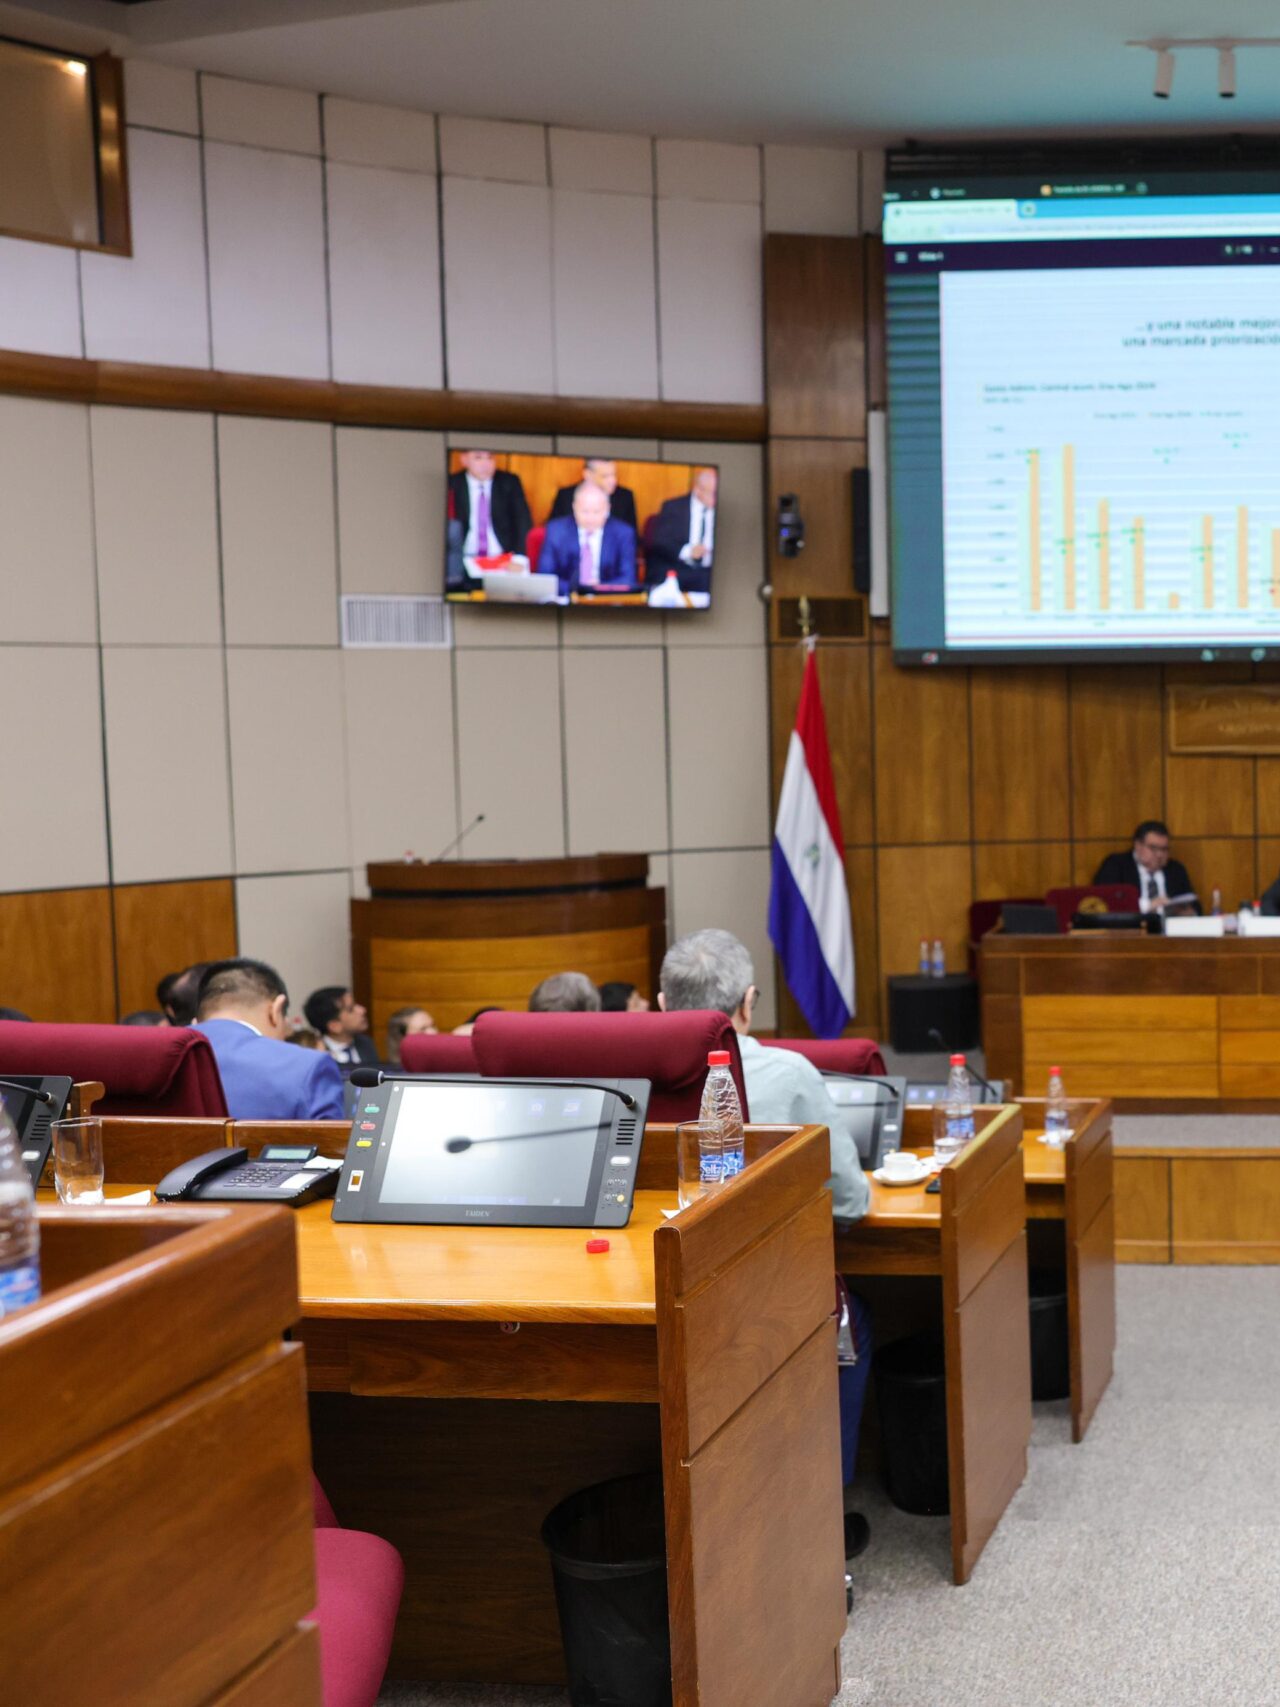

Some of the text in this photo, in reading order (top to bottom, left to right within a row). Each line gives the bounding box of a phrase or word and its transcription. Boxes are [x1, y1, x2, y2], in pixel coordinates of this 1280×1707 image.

[1157, 320, 1181, 330] una
[1185, 318, 1235, 329] notable
[1122, 336, 1146, 346] una
[1151, 334, 1206, 346] marcada
